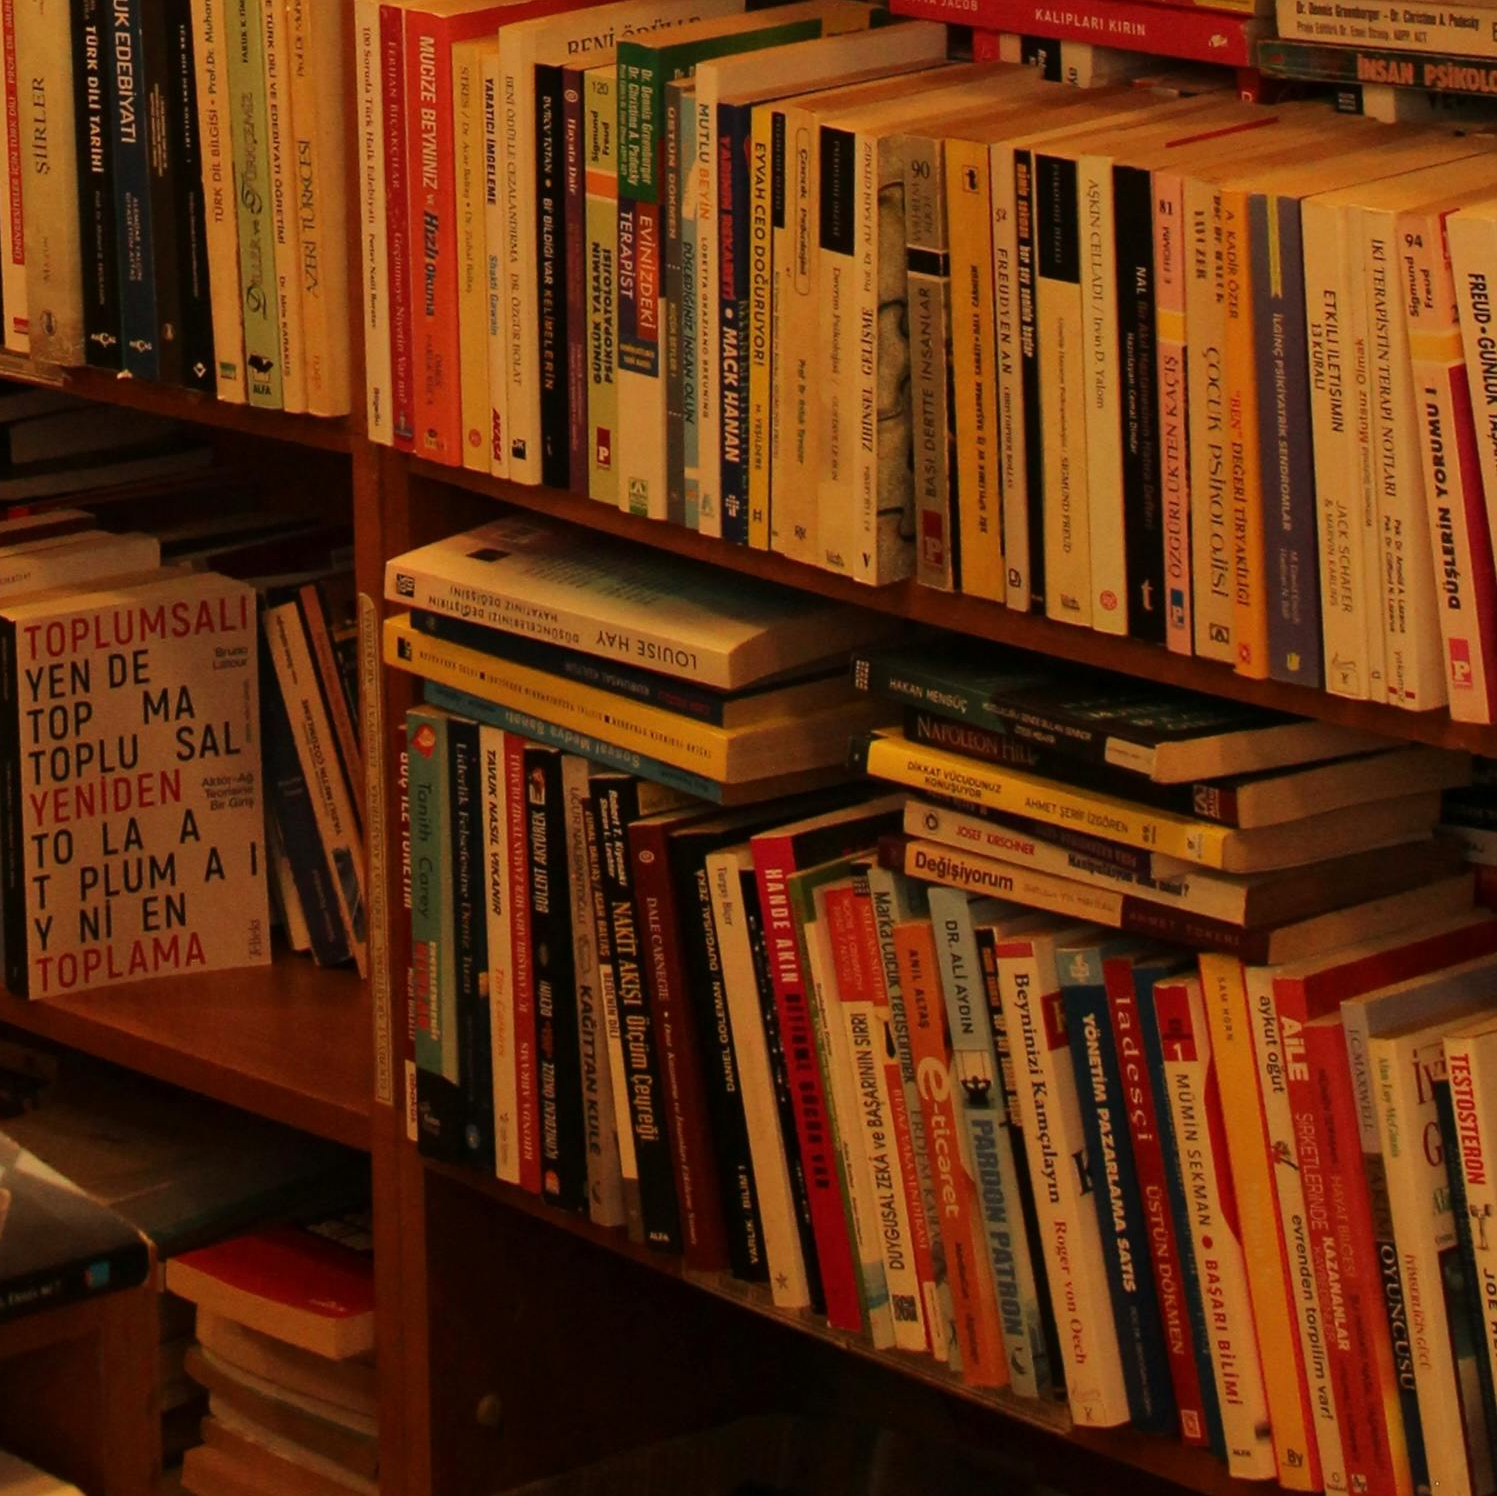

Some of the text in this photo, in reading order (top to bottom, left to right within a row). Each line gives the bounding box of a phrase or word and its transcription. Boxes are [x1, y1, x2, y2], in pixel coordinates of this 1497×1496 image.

[1034, 7, 1146, 37] KALIPLARI KIRIN
[114, 33, 136, 142] EDEBİYATI
[618, 211, 656, 332] EVİNİZDEKİ TERAPİST
[752, 143, 770, 366] EYVAH CEO DOĞURUYOR!
[722, 327, 740, 462] MACK HANAN
[1202, 347, 1230, 597] ÇOCUK PSİKOLOJİSİ
[25, 596, 248, 660] TOPLUMSALI
[26, 649, 151, 702] YEN DE
[597, 629, 699, 670] LOUISE HAY
[26, 685, 195, 744] TOP MA
[28, 721, 241, 785] TOPLU SAL
[30, 768, 182, 826] YENİDEN
[763, 868, 798, 984] HANDE AKIN
[914, 850, 1014, 891] Değişiyorum
[36, 932, 206, 992] TOPLAMA
[944, 920, 974, 1034] DR. ALİ AYDIN
[612, 901, 659, 1141] NAKİT AKIŞI Ölçüm Çeyreği
[916, 1057, 961, 1219] e-ticaret
[1012, 973, 1089, 1364] Beyninizi Kamçılayın Roger von Oech
[1450, 1053, 1486, 1185] TESTOSTERON
[972, 1120, 1024, 1336] PARDON PATRON
[1175, 1074, 1242, 1405] MÜMİN SEKMAN BAŞARI BİLİMİ
